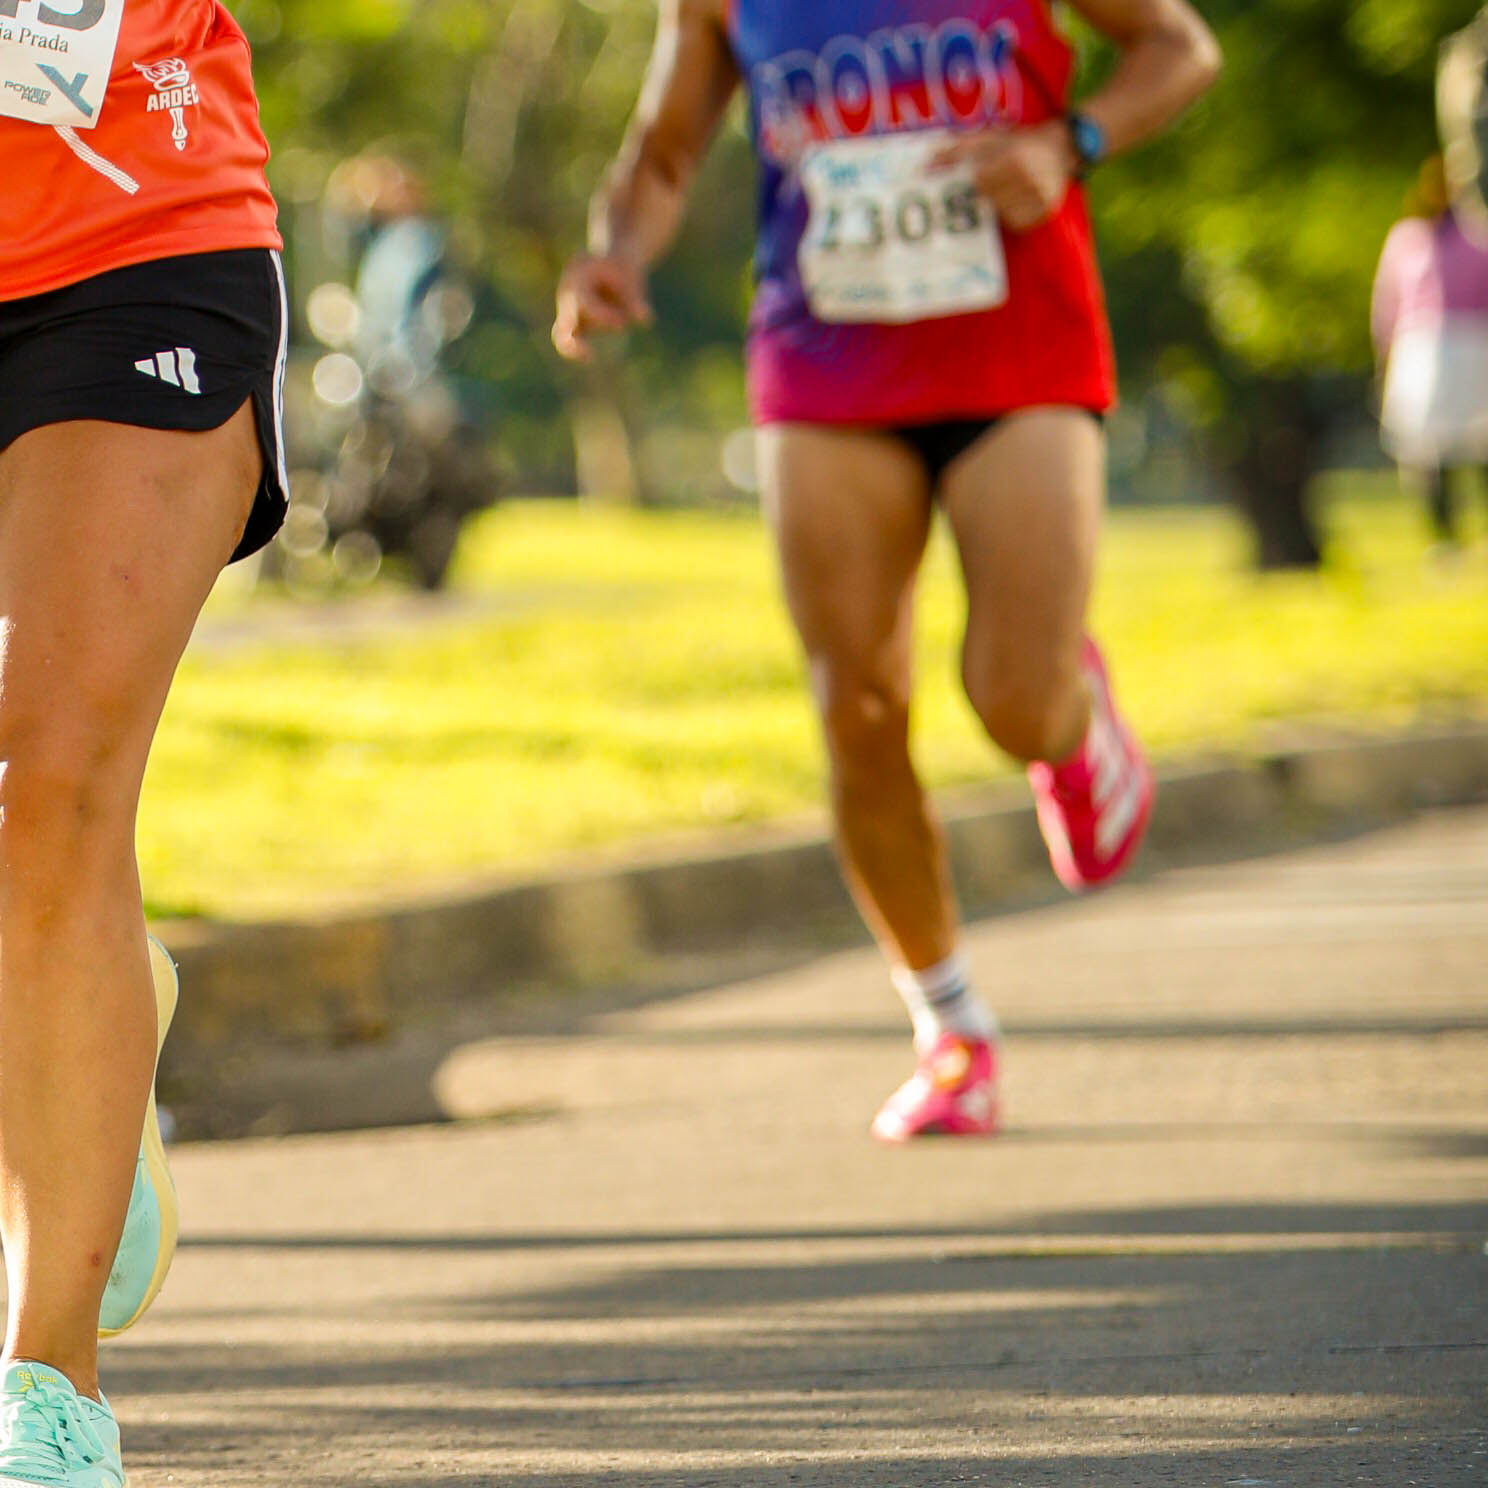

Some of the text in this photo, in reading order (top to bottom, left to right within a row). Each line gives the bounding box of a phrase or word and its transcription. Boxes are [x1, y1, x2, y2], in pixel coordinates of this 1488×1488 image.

[19, 27, 69, 54] Prada
[4, 80, 51, 97] POWER
[15, 1369, 57, 1385] Rebok
